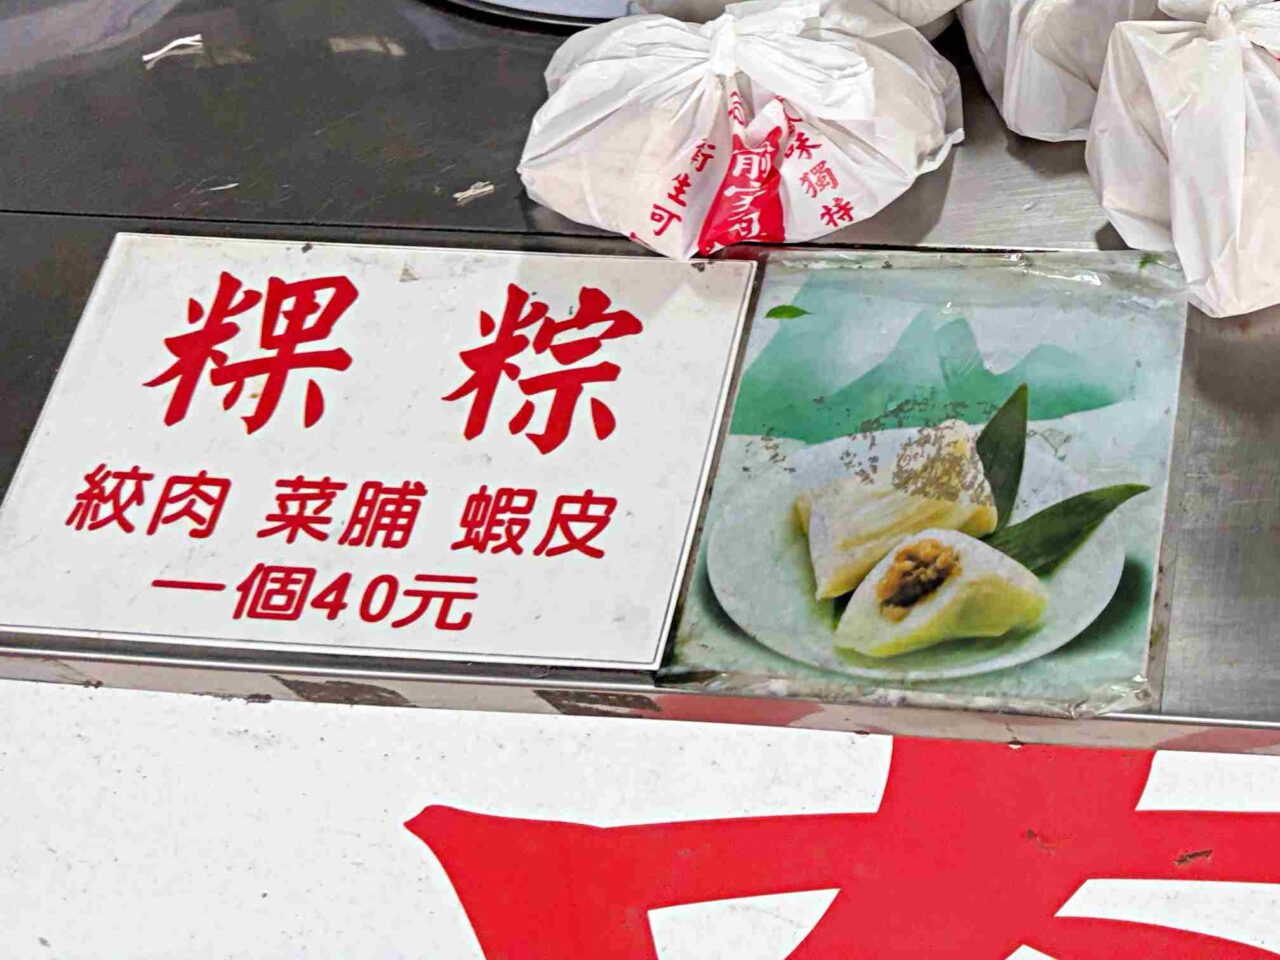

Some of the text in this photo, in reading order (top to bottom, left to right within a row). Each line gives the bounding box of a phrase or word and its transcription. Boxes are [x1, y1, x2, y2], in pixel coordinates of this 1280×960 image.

[144, 271, 644, 455] 粿粽
[64, 463, 618, 559] 絞肉 菜脯 蝦皮
[151, 562, 478, 631] 一個40元
